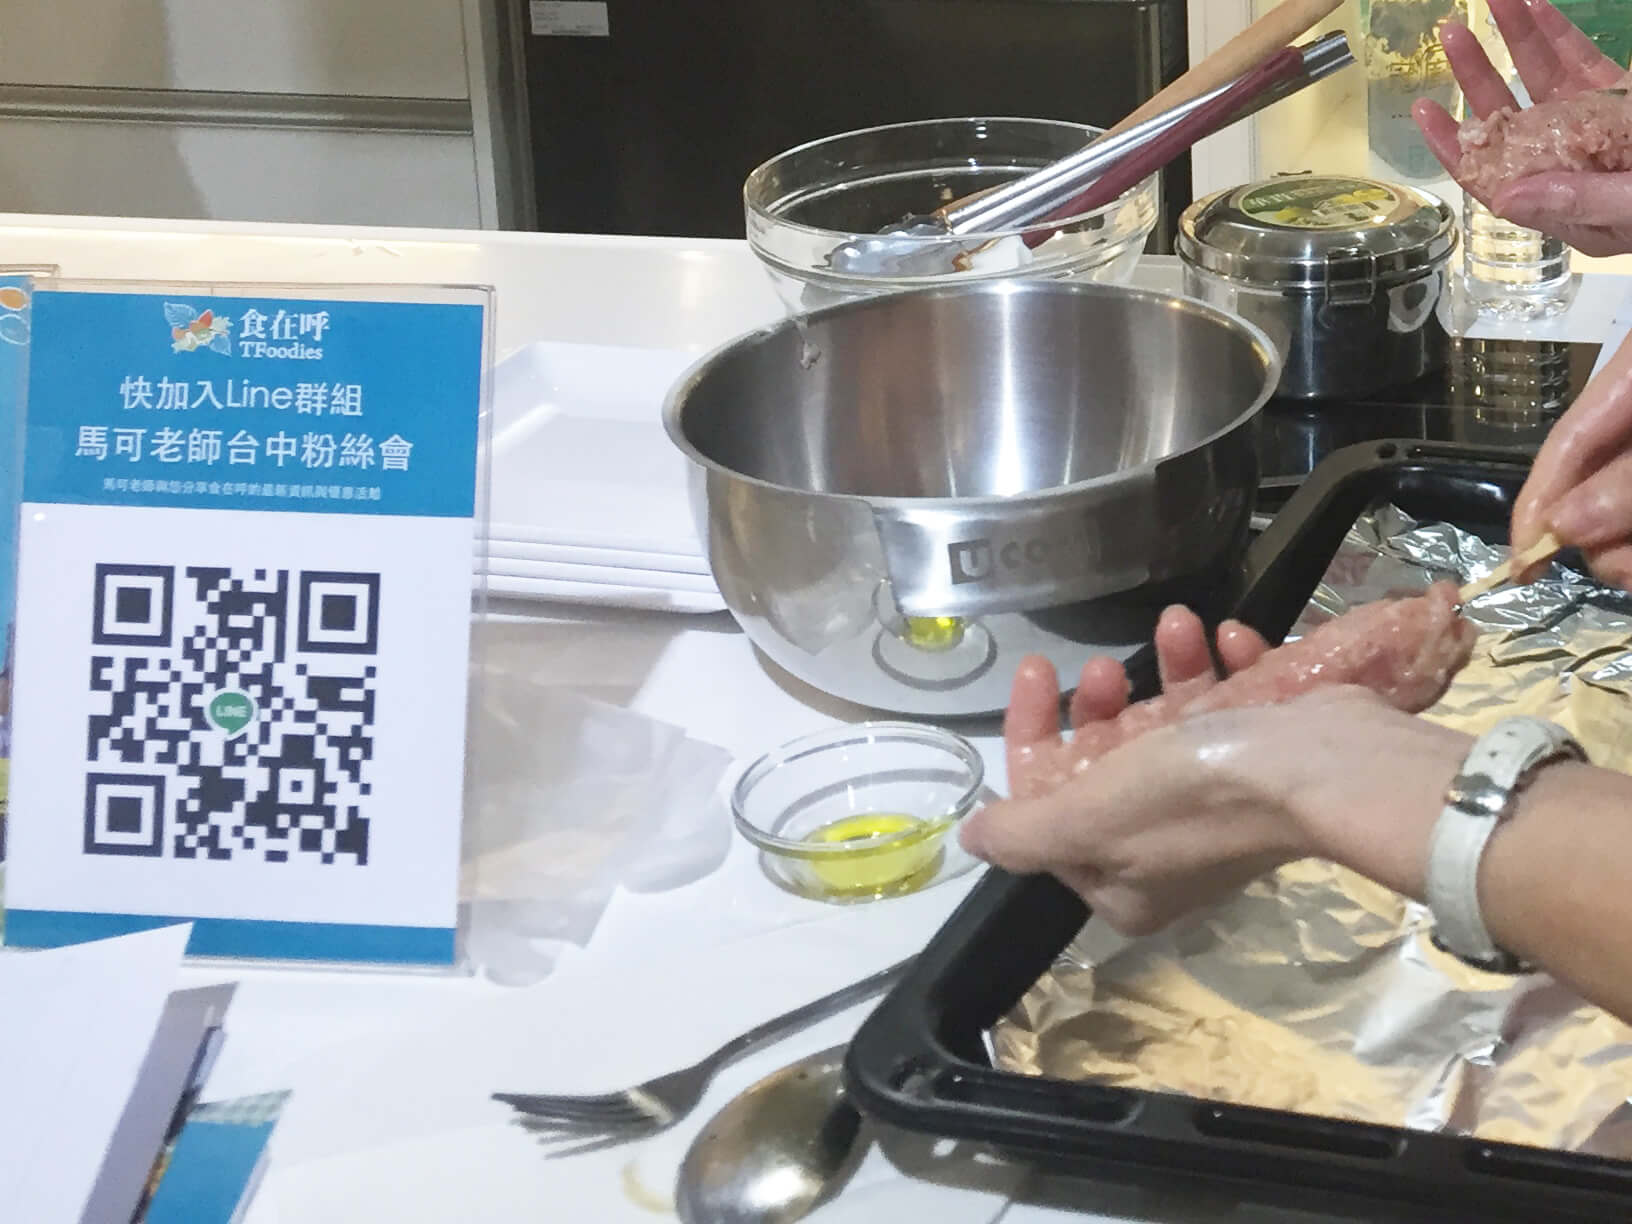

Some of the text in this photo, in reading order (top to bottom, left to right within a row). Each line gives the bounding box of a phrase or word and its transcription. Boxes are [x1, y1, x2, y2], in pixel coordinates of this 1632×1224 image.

[239, 308, 331, 341] 食在呼
[239, 341, 323, 360] TFoodies
[119, 375, 364, 416] 快加入Line群組
[75, 425, 414, 471] 馬可老師台中粉絲會
